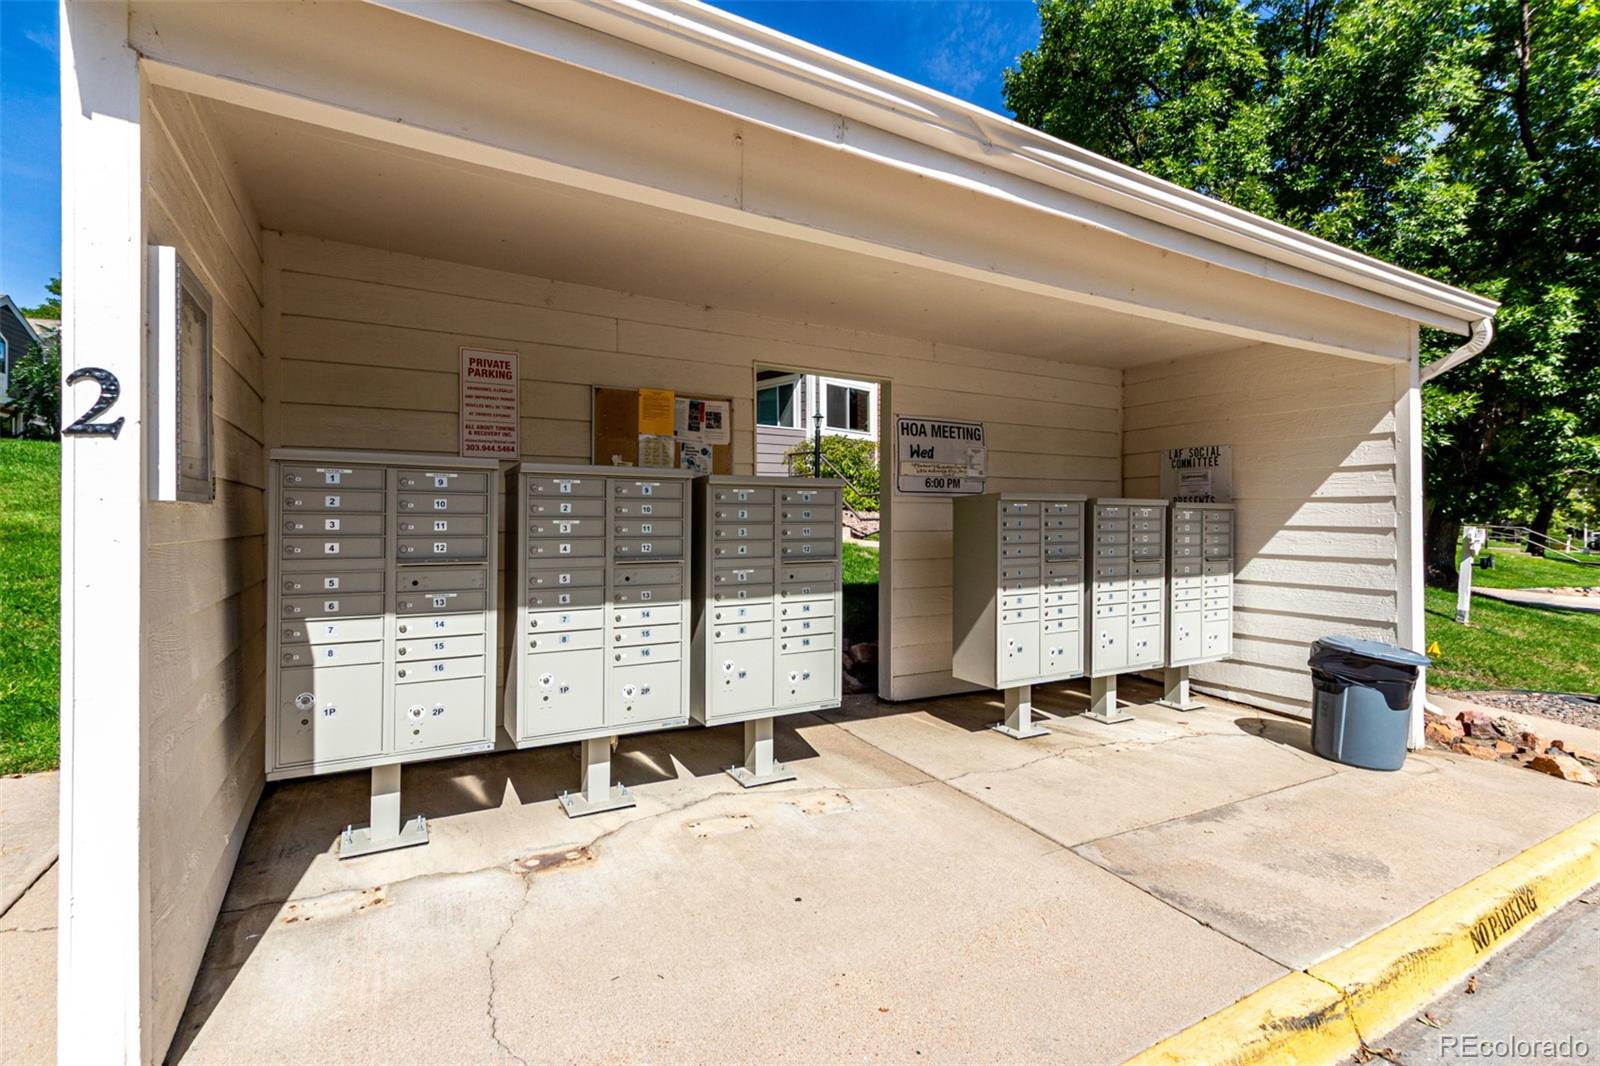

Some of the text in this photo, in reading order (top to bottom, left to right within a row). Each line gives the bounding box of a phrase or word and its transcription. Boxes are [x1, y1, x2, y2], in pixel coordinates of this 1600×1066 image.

[468, 358, 512, 370] PRIVATE
[468, 368, 512, 380] PARKING
[61, 366, 126, 440] 2
[900, 422, 982, 441] HOA MEETING
[910, 444, 935, 459] Wed
[1169, 446, 1221, 460] LAF SOCIAL
[1171, 456, 1219, 469] COMMITTEE
[437, 478, 444, 487] 9
[925, 478, 961, 489] 6:00 PM
[329, 497, 336, 506] 2
[1173, 494, 1216, 503] PRESENTS
[435, 500, 446, 508] 10
[562, 504, 569, 512] 2
[328, 520, 336, 529] 3
[435, 521, 446, 530] 11
[562, 524, 568, 532] 3
[641, 524, 651, 533] 11
[328, 544, 335, 553] 4
[435, 543, 446, 552] 12
[562, 544, 568, 553] 4
[641, 543, 651, 552] 12
[328, 578, 335, 587] 5
[562, 574, 568, 583] 5
[561, 594, 568, 603] 6
[641, 591, 651, 600] 13
[328, 602, 335, 611] 6
[434, 598, 445, 607] 13
[640, 610, 650, 619] 14
[561, 615, 568, 624] 7
[434, 620, 445, 629] 14
[327, 626, 334, 635] 7
[640, 630, 650, 638] 15
[434, 642, 444, 651] 15
[327, 649, 334, 658] 8
[433, 663, 444, 672] 16
[559, 686, 570, 694] 1P
[640, 687, 651, 695] 2P
[323, 708, 336, 716] 1P
[432, 708, 445, 716] 2P
[1469, 886, 1538, 954] NO PARKING
